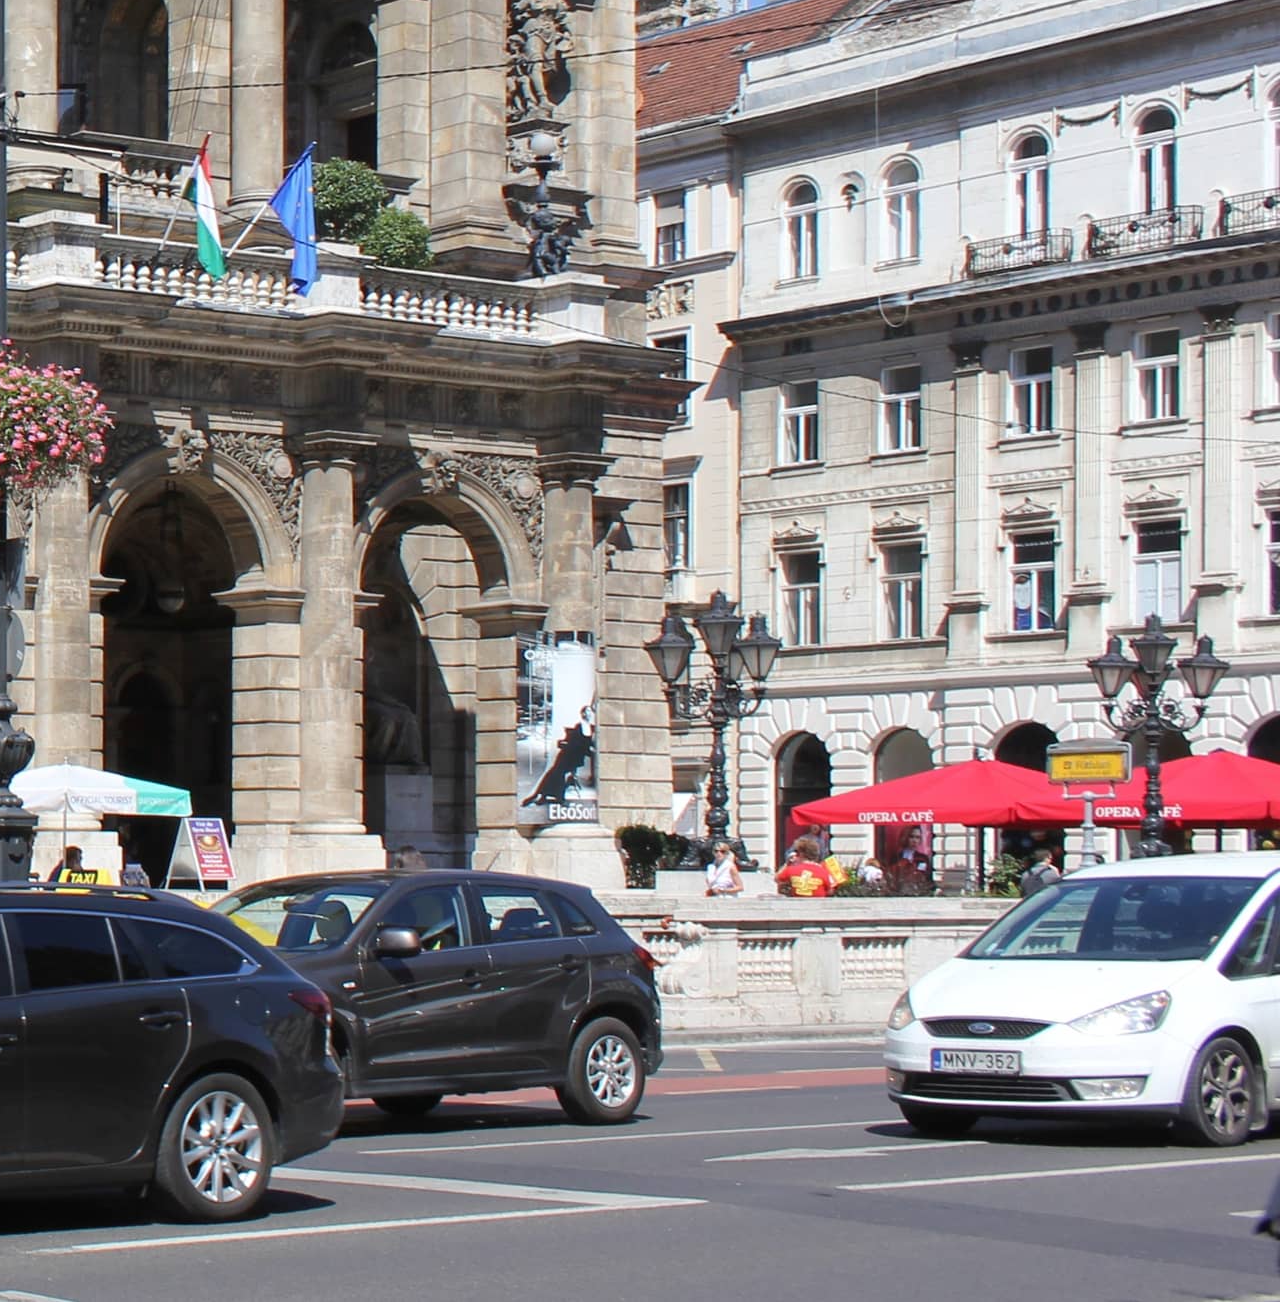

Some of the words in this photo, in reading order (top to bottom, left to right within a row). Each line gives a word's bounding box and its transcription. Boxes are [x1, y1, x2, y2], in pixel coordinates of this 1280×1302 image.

[70, 795, 101, 805] OFFICIAL
[103, 795, 133, 805] TOURIST
[858, 811, 898, 823] OPERA
[1095, 806, 1141, 818] OPERA
[71, 872, 96, 885] TAXI
